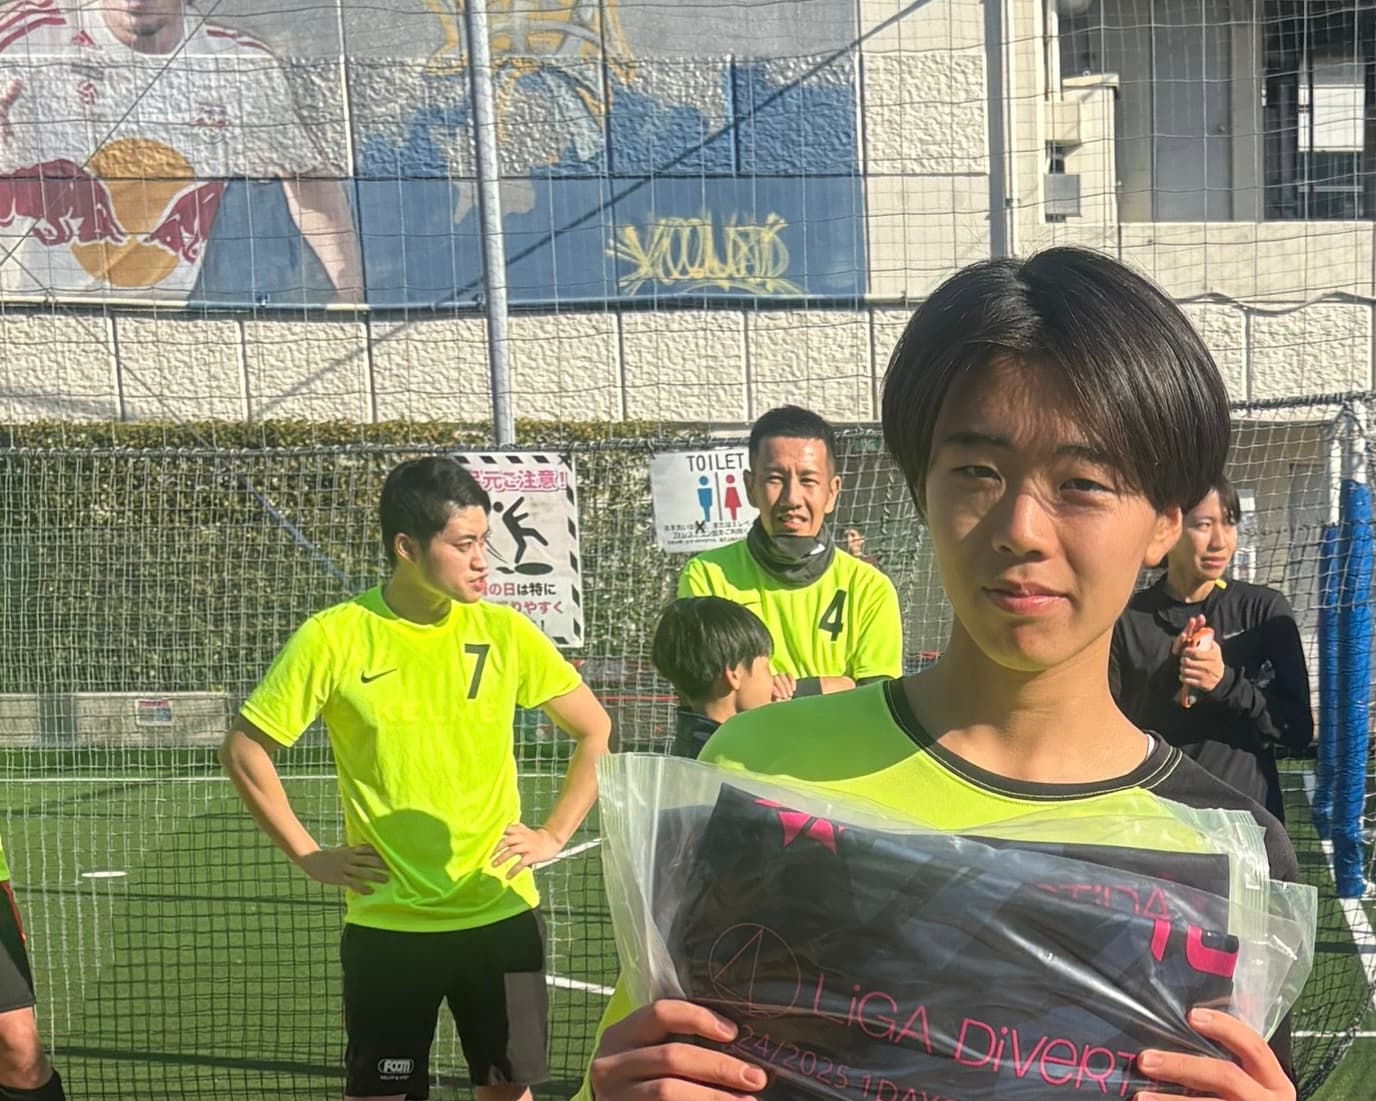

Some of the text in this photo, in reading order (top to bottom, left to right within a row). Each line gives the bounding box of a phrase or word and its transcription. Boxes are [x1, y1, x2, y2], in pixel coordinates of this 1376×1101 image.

[686, 453, 744, 472] TOILET
[483, 583, 557, 597] の日は特に
[502, 601, 564, 614] りやすく
[818, 589, 847, 641] 4
[464, 643, 490, 699] 7
[736, 1024, 849, 1089] 24/2025
